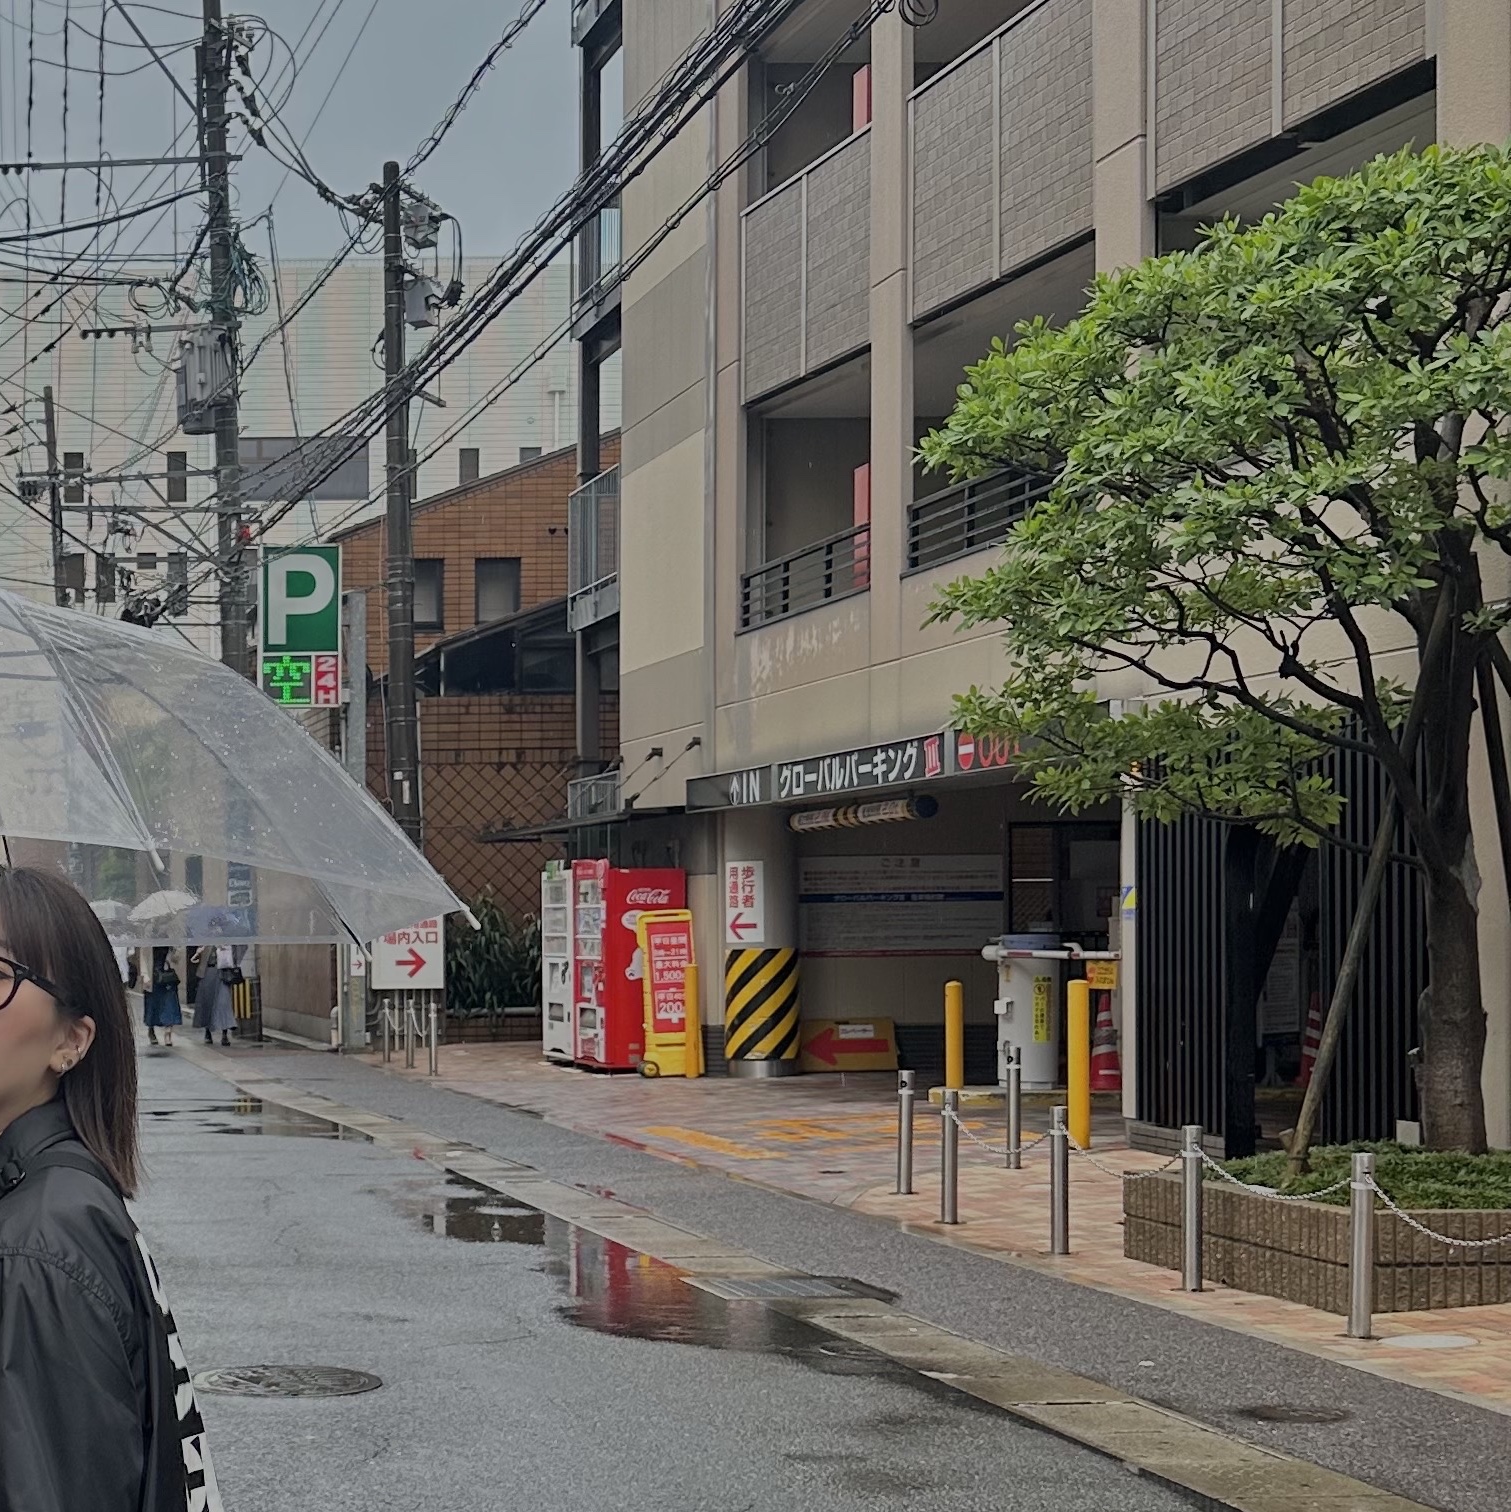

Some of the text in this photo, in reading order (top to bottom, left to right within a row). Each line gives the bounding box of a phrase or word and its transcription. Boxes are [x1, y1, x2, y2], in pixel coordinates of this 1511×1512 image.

[268, 553, 335, 645] P
[262, 655, 311, 704] 空
[316, 656, 337, 704] 24H
[742, 769, 761, 804] IN
[741, 865, 756, 909] 歩行者
